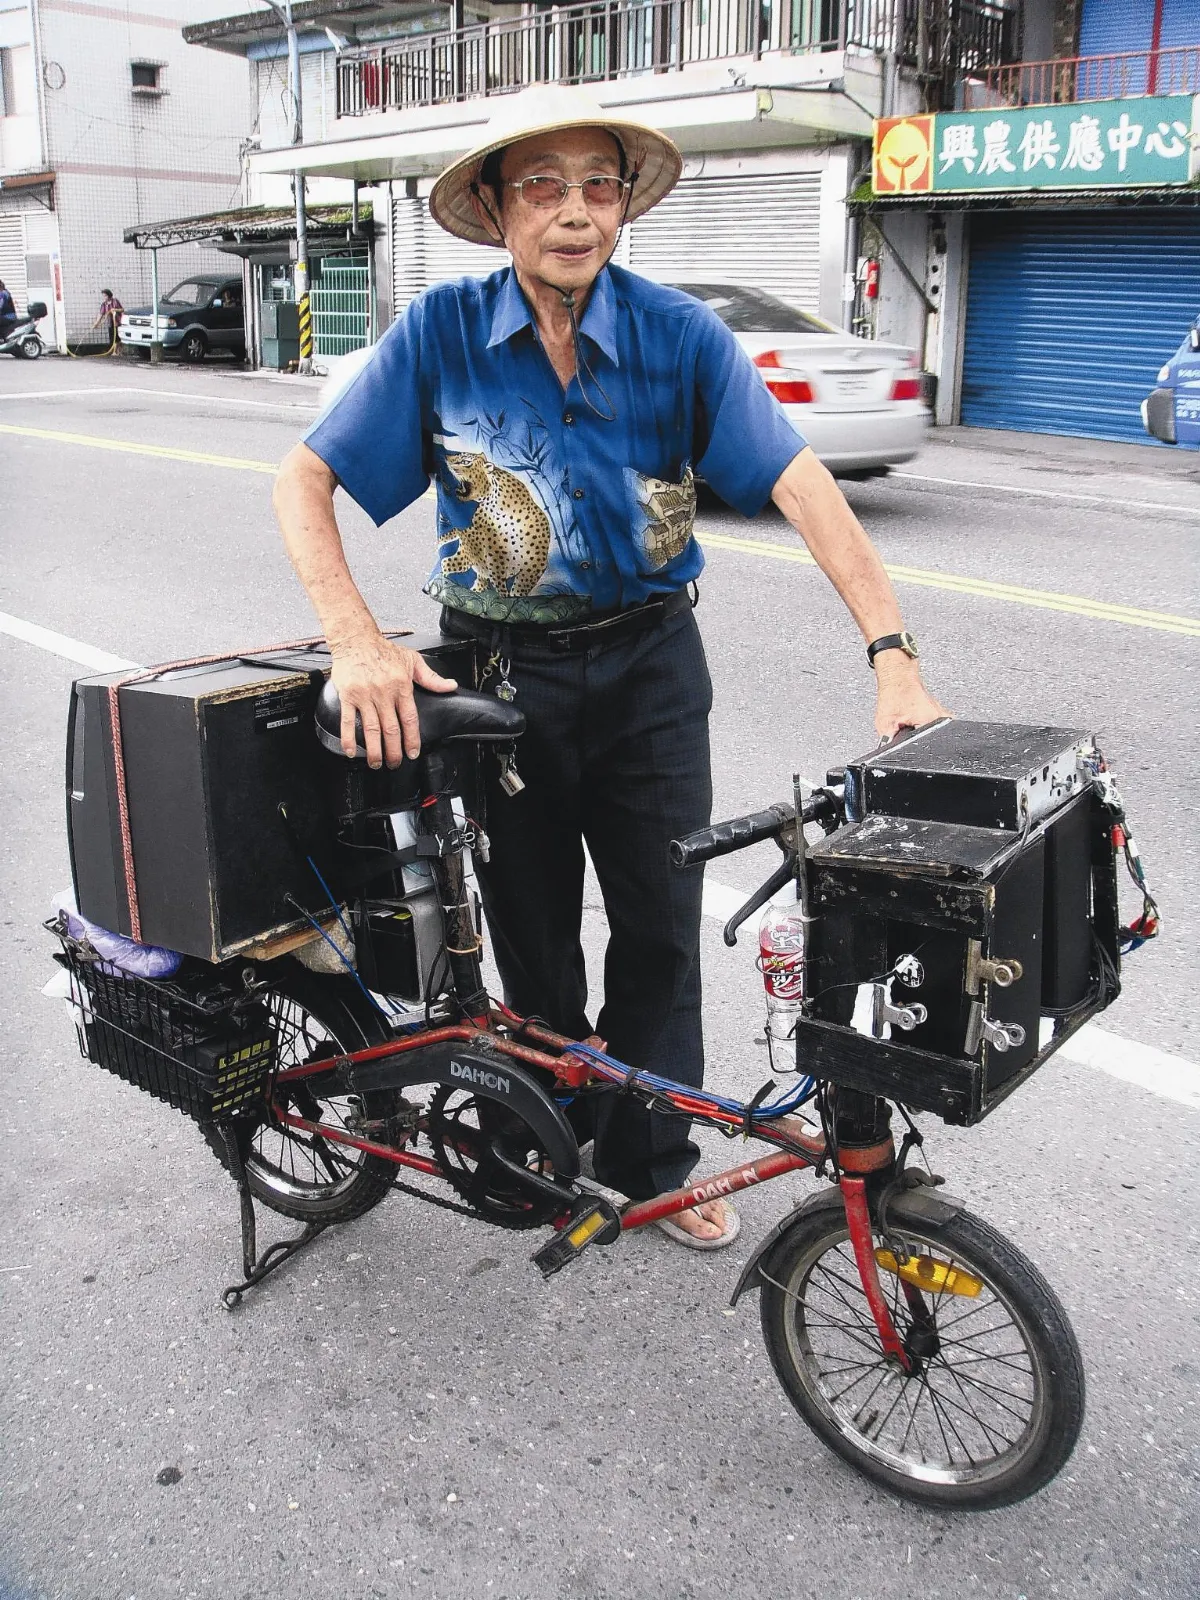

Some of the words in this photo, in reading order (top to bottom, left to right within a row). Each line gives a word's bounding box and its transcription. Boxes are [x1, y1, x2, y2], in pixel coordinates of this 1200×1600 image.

[939, 112, 1187, 175] 興農供應中心
[450, 1060, 510, 1094] DAHON
[692, 1166, 760, 1203] DAHN
